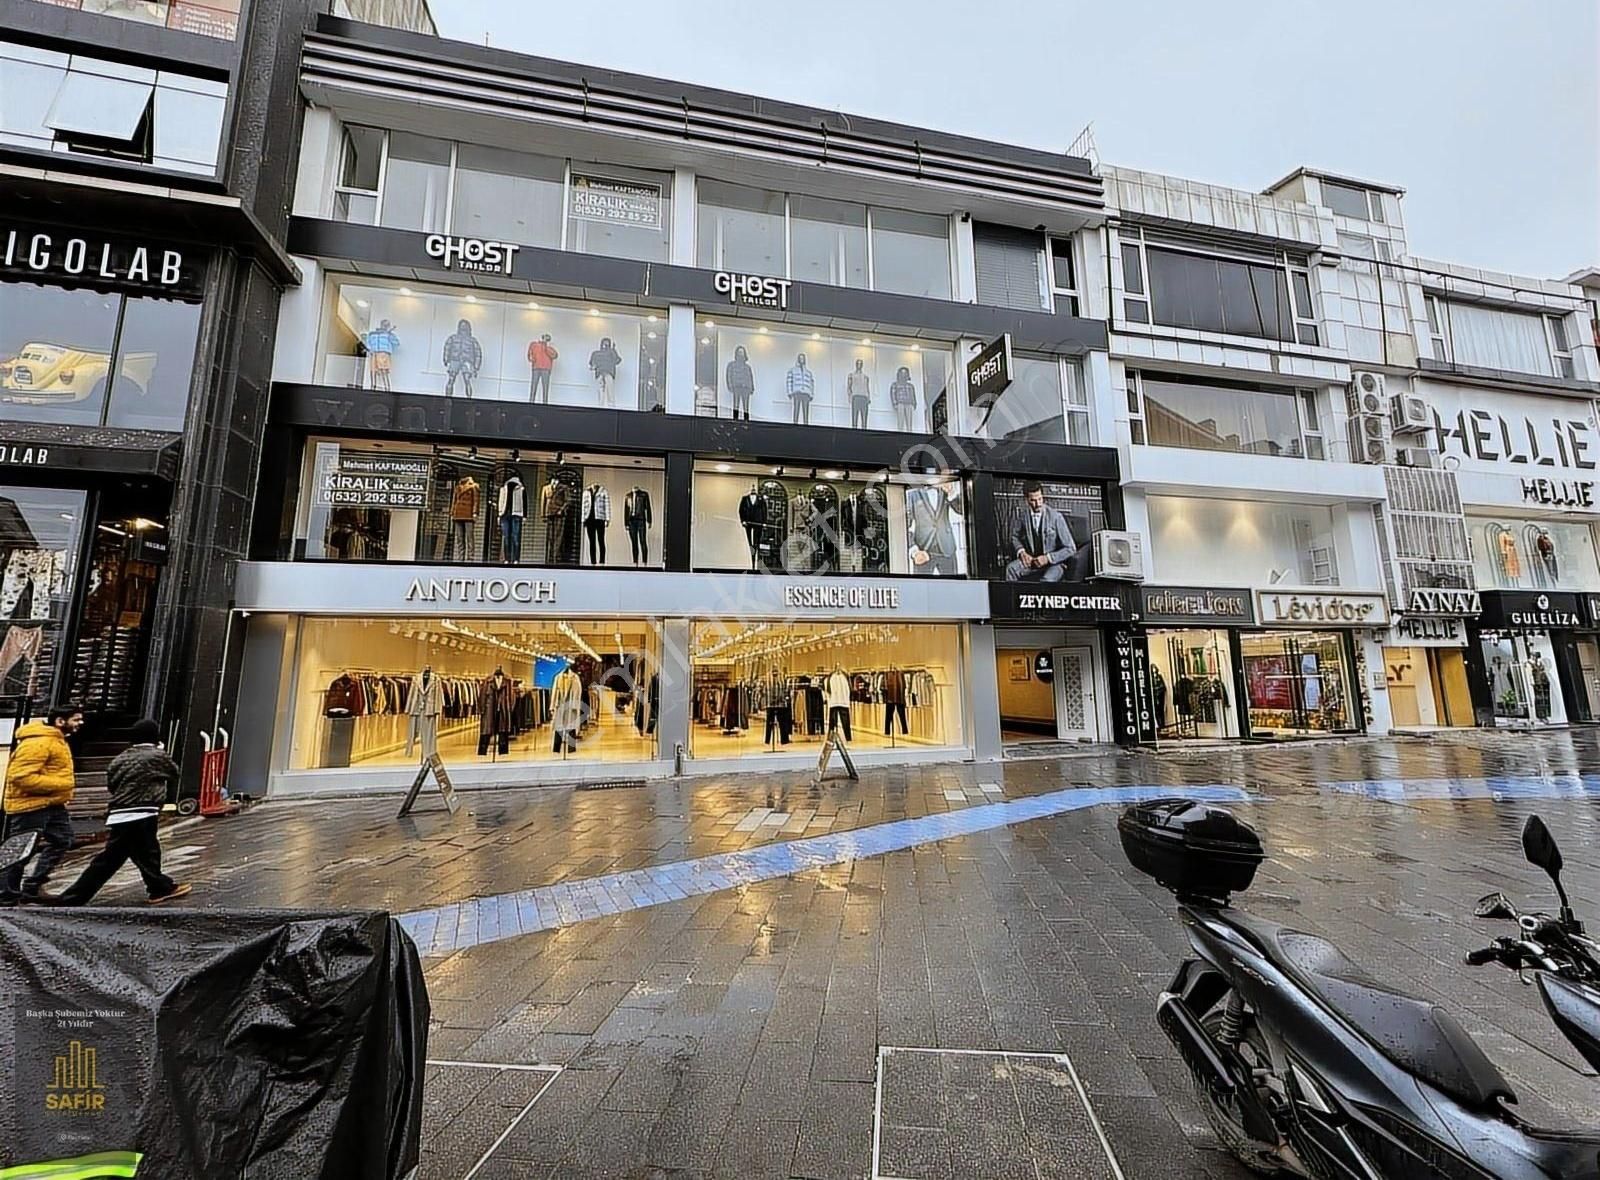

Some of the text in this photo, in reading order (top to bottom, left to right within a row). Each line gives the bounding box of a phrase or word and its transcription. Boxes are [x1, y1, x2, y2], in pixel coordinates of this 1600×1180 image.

[4, 230, 182, 285] IGOLAB
[425, 234, 520, 276] GHOST
[458, 260, 501, 273] TAILOR
[714, 271, 793, 309] GHOST
[741, 295, 778, 307] TAILOR
[970, 351, 1003, 387] GHOST
[325, 473, 391, 491] KİRALIK
[405, 577, 557, 604] ANTIOCH
[784, 585, 899, 609] ESSENCE OF LIFE
[1019, 594, 1122, 611] ZEYNEP CENTER
